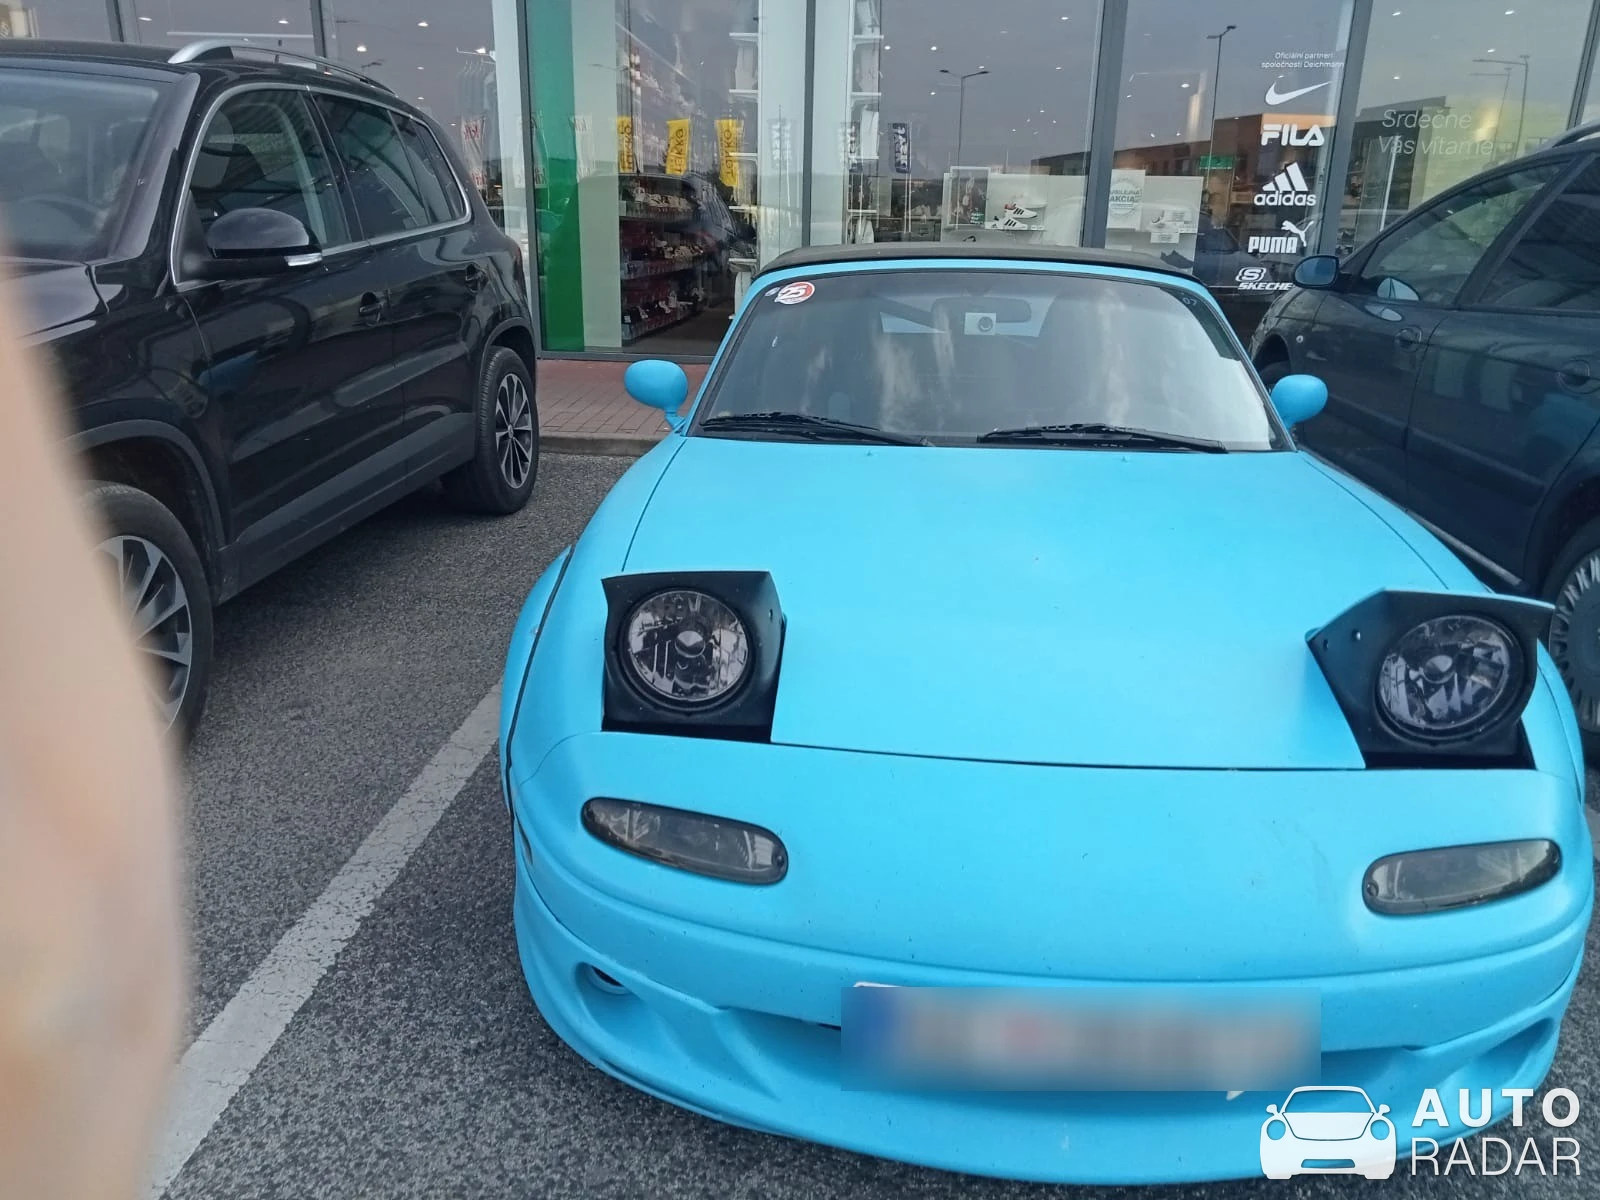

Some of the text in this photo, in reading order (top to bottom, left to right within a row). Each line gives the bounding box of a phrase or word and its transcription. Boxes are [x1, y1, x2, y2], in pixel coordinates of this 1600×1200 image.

[1304, 52, 1334, 61] partneri
[1382, 109, 1472, 128] Srdečne
[1261, 124, 1325, 146] FILA
[1379, 135, 1415, 155] Vás
[1254, 191, 1316, 206] adidas
[1248, 236, 1298, 253] PUMA
[1238, 282, 1294, 290] SKECHE
